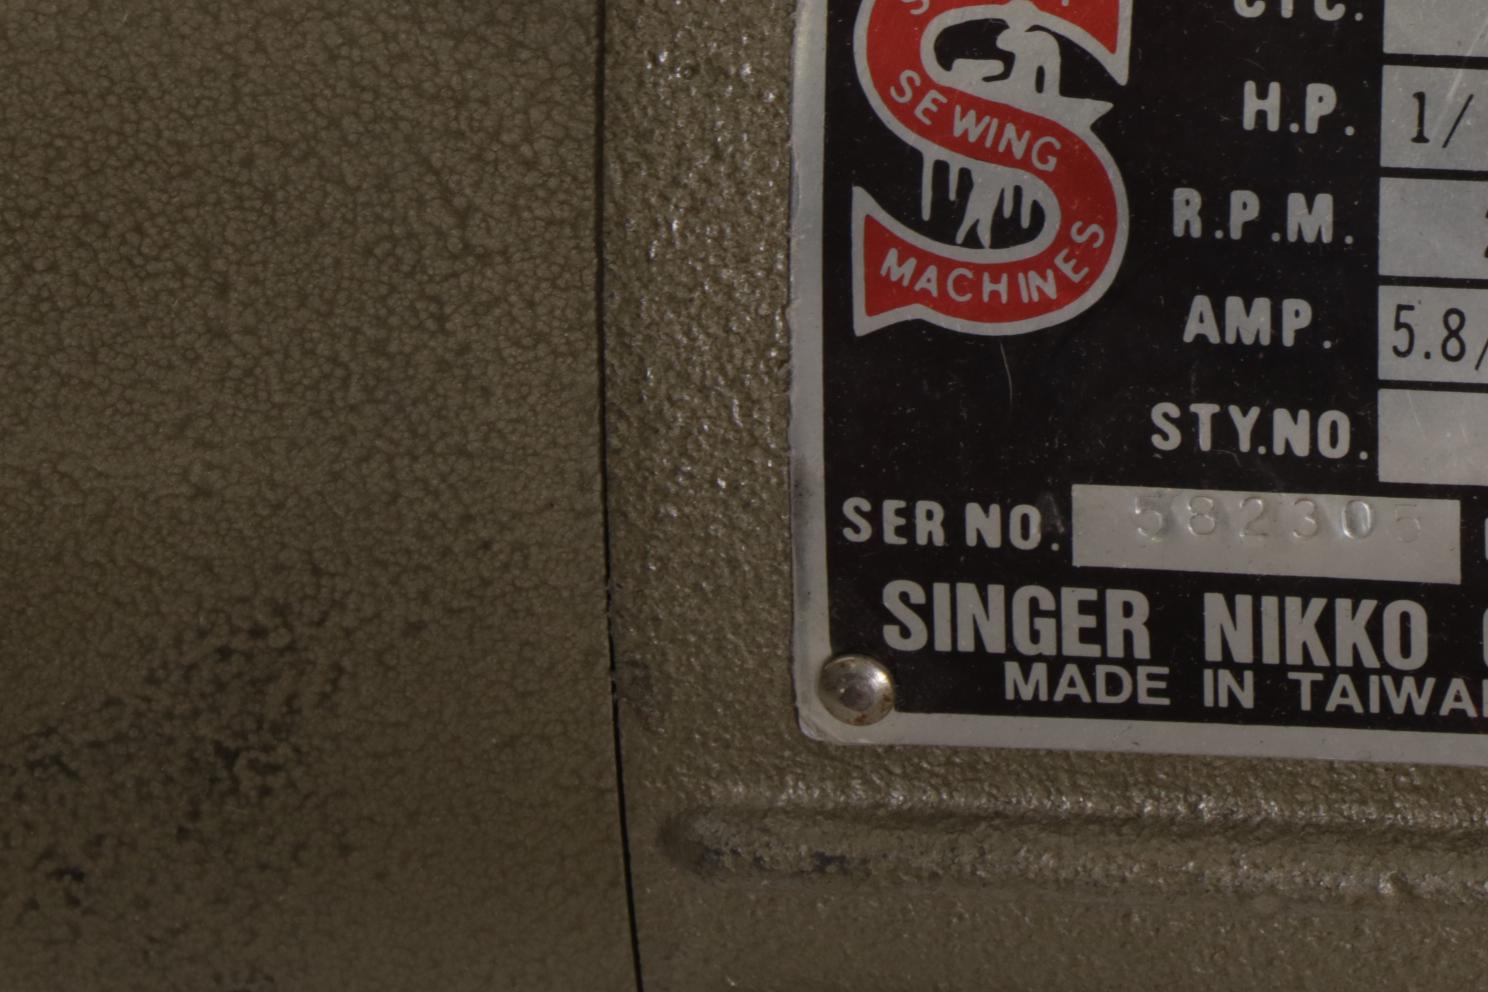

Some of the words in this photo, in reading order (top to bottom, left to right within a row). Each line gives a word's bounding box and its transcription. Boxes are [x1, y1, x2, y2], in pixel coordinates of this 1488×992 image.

[890, 69, 1061, 173] SEWING
[1242, 81, 1356, 135] H.P.
[1172, 187, 1354, 244] R.P.M.
[880, 220, 1105, 304] MACHINES
[1182, 295, 1332, 349] AMP.
[842, 496, 946, 547] SER
[965, 502, 1061, 552] NO.
[882, 579, 1151, 660] SINGER
[1204, 592, 1430, 671] NIKKO
[1004, 661, 1171, 706] MADE
[1203, 670, 1255, 709] IN
